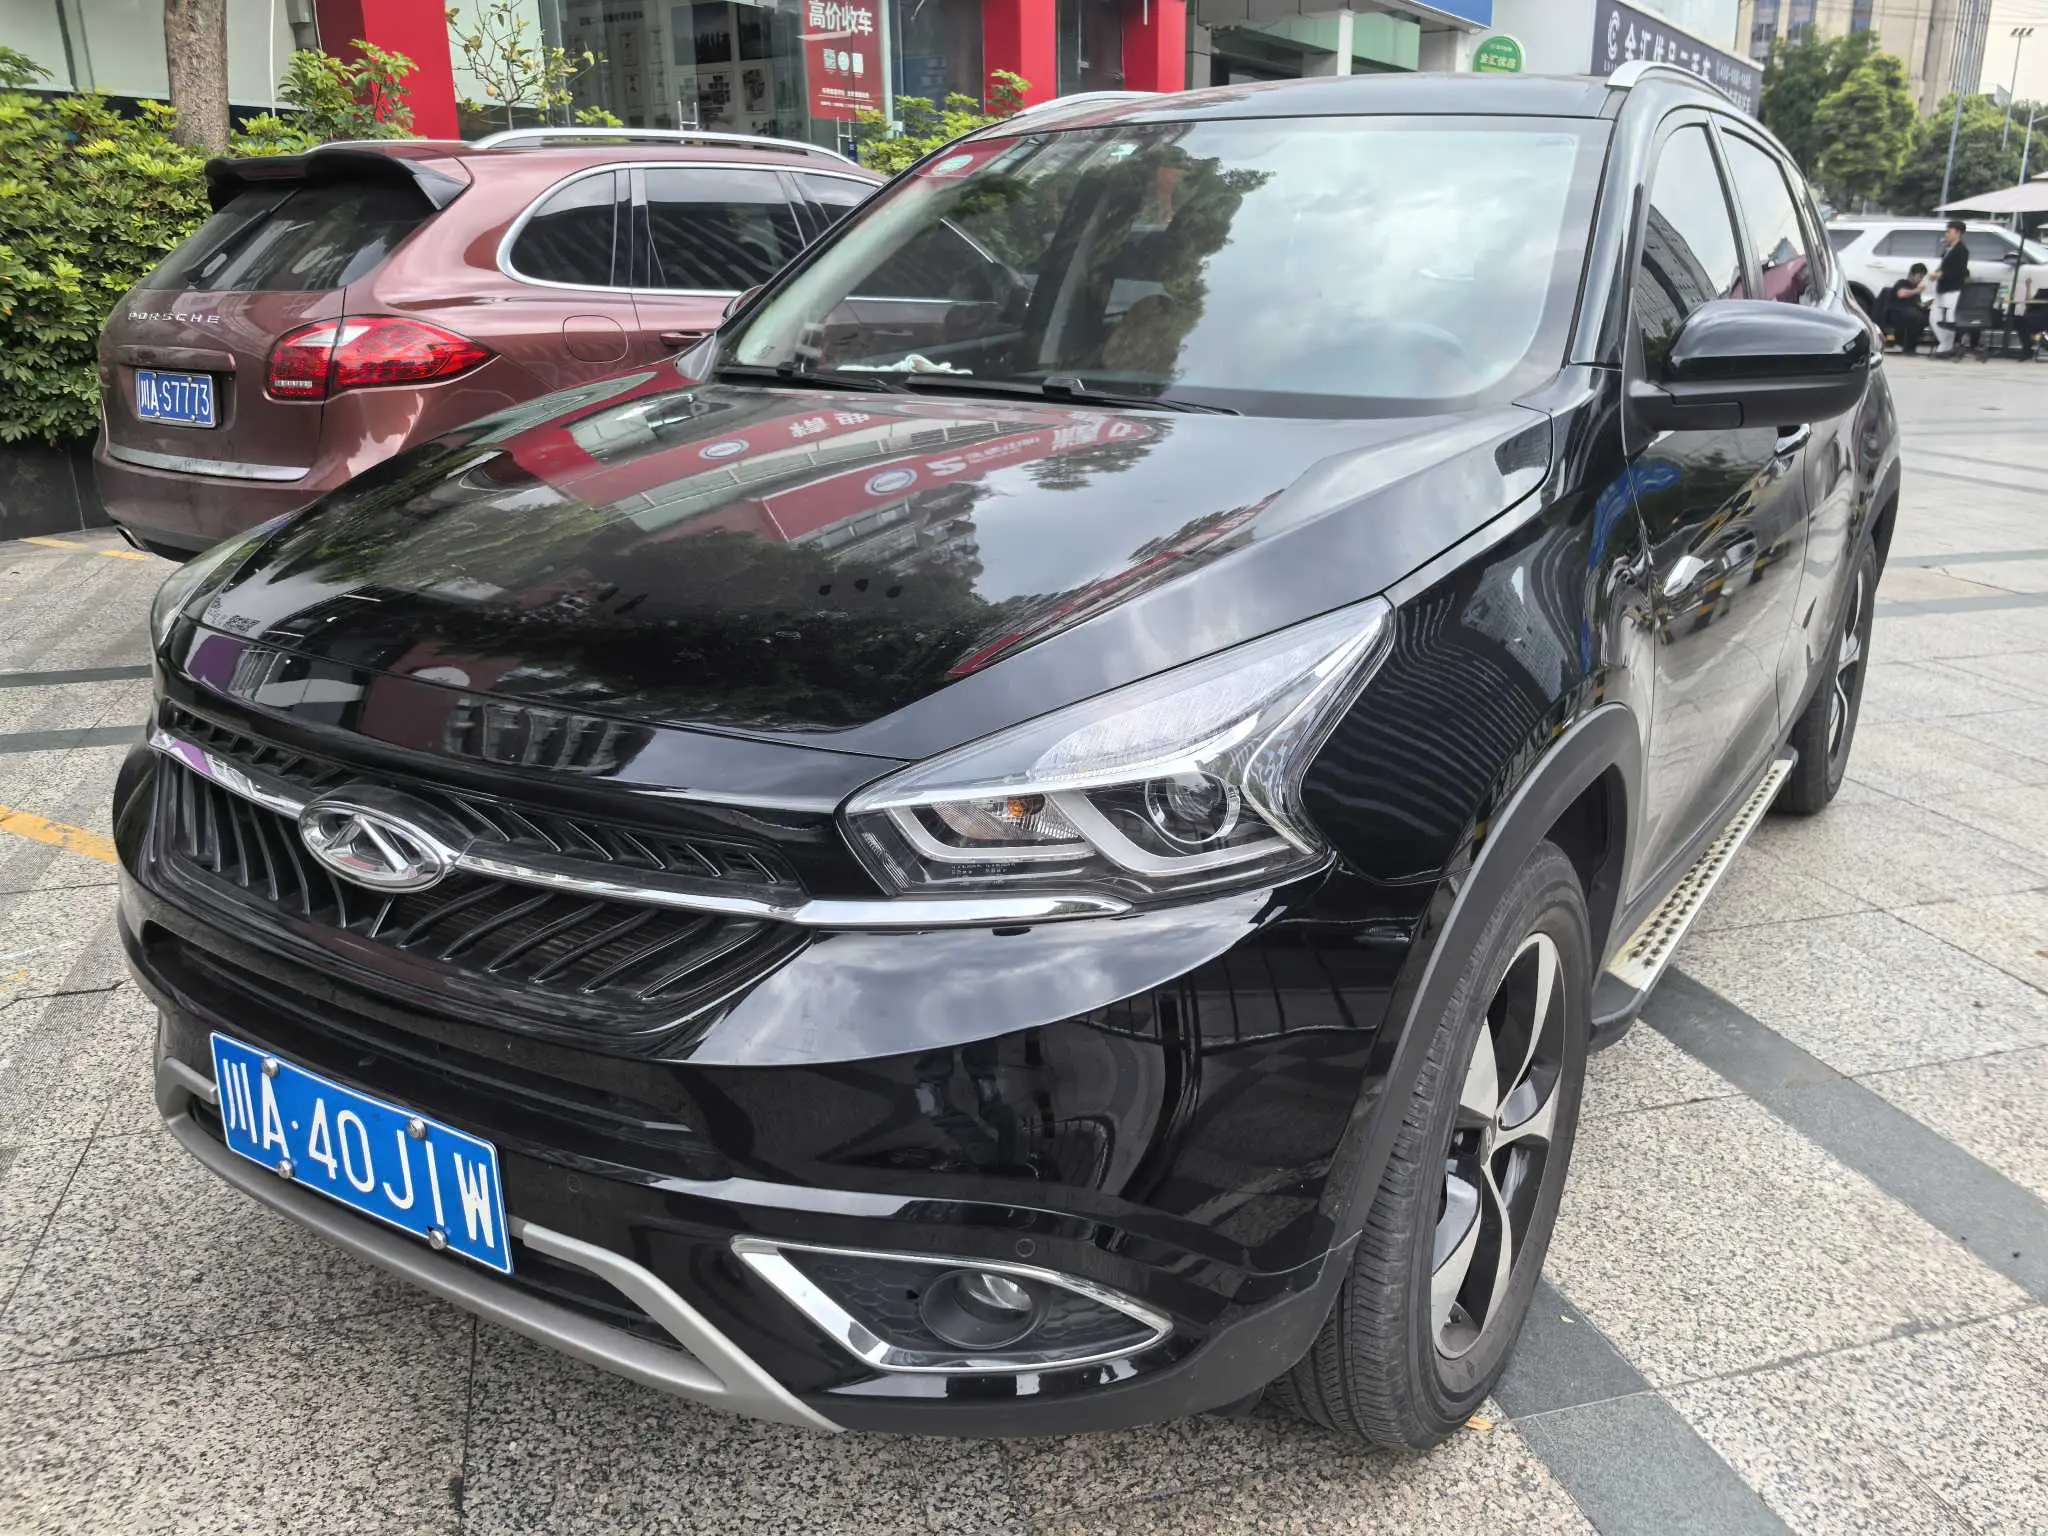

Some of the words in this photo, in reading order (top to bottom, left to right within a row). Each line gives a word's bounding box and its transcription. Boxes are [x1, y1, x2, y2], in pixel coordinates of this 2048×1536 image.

[808, 0, 873, 36] 高价收车
[128, 311, 221, 324] PORSCHE
[140, 377, 210, 416] 川A·S7773
